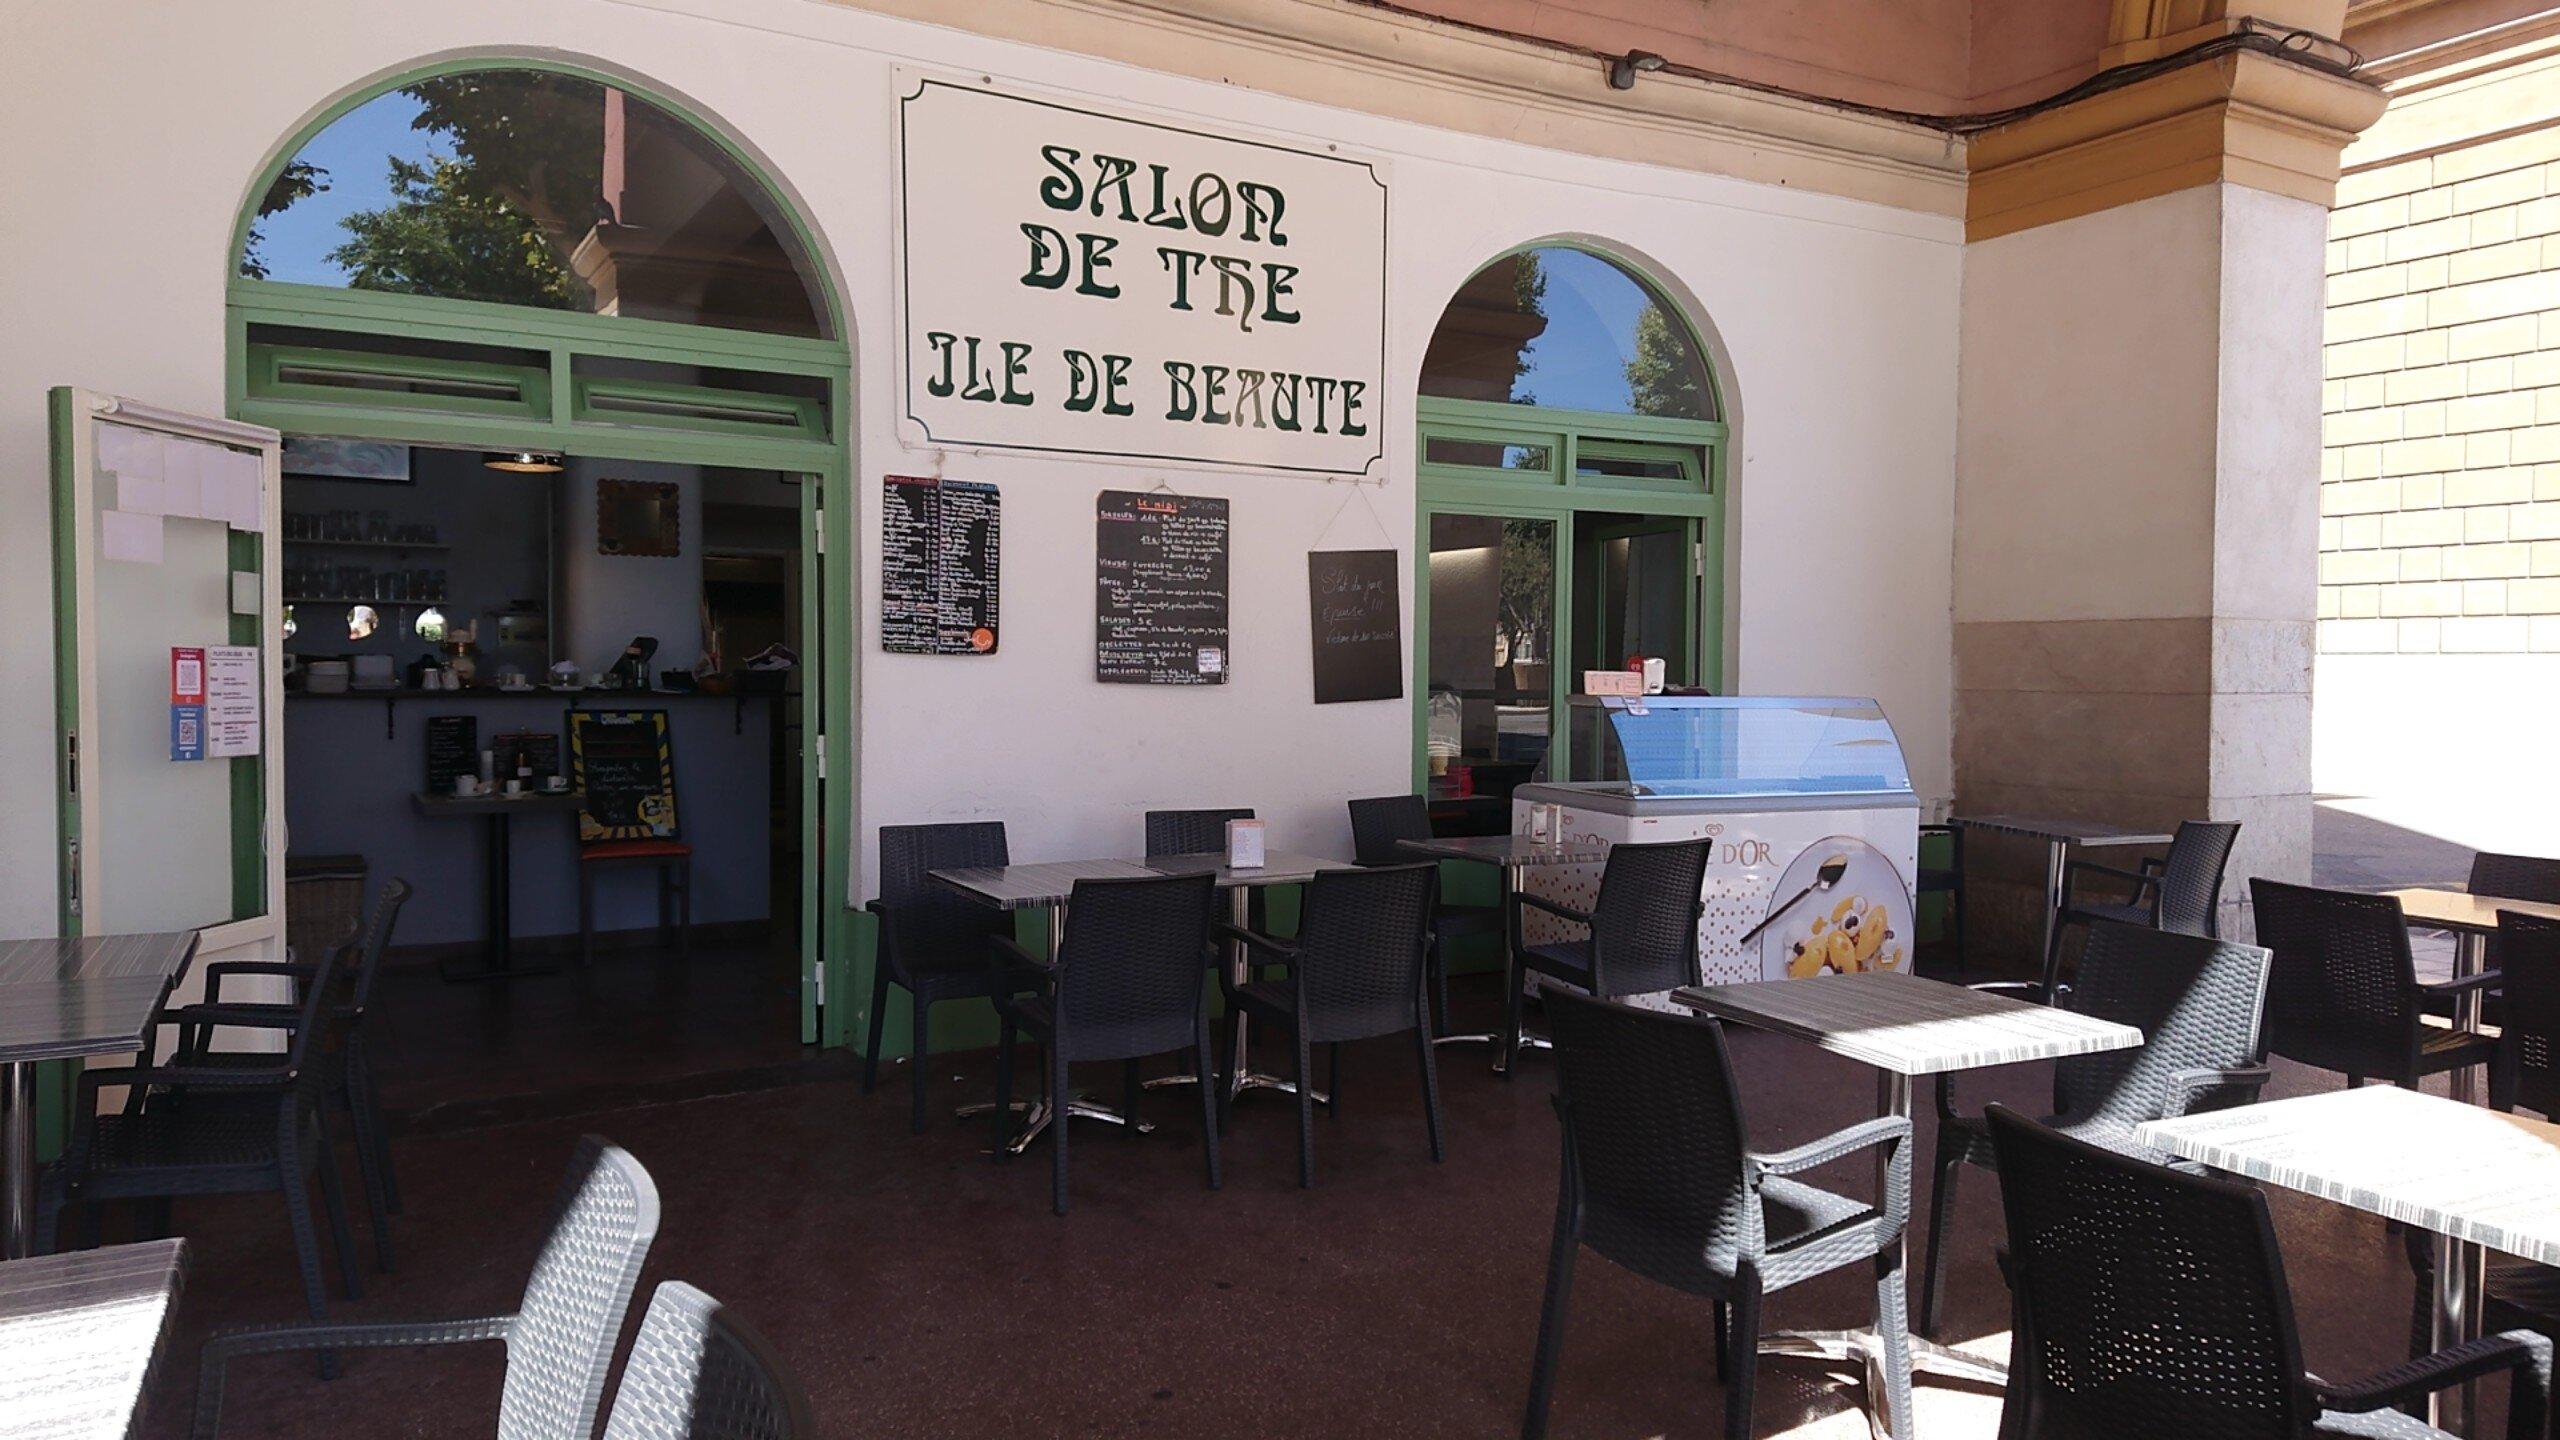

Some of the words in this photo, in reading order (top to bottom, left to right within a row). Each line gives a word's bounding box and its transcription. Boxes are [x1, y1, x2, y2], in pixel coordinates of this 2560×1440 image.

[1039, 144, 1289, 247] SALON
[1019, 221, 1122, 299] DE
[1155, 245, 1302, 333] THE
[1061, 347, 1135, 417] DE
[1162, 359, 1368, 438] BEAUTE
[1722, 839, 1780, 867] D'OR
